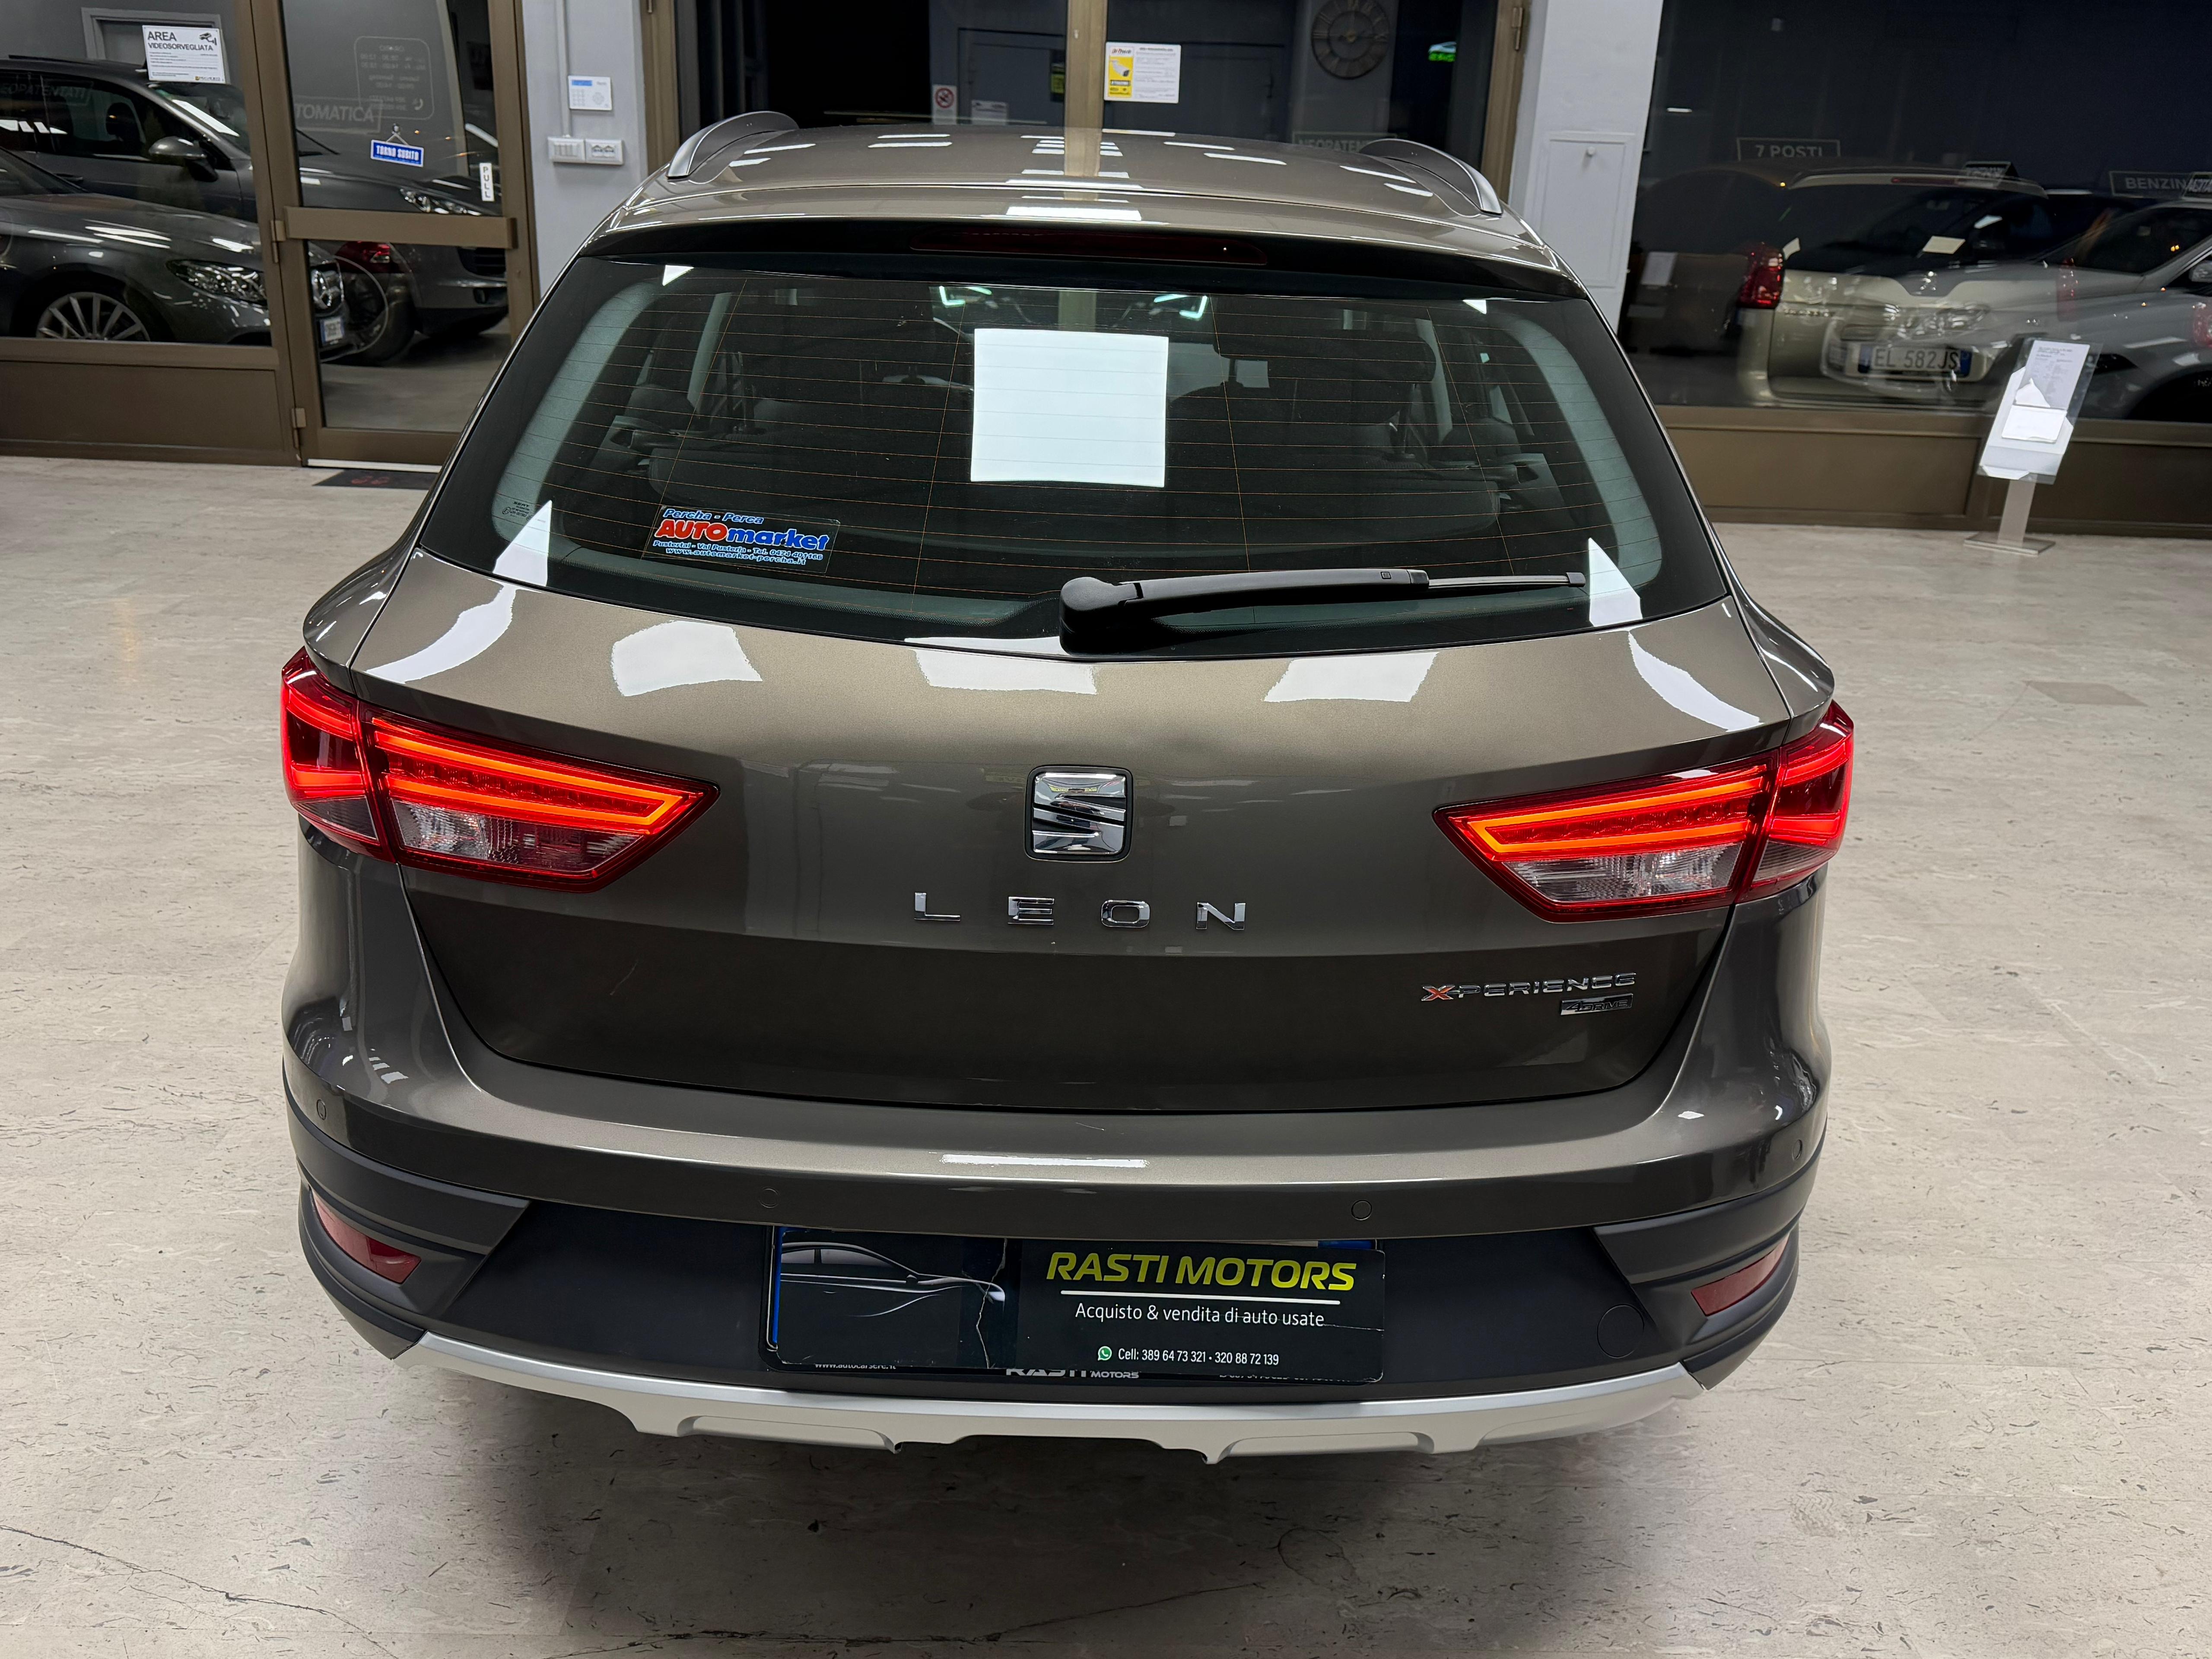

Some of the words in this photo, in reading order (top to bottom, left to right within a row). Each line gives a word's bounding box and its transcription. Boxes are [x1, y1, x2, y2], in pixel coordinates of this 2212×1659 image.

[148, 31, 177, 41] AREA
[148, 43, 213, 51] VIDEOSORVEGLIATA
[376, 145, 396, 157] TORNO
[397, 149, 419, 161] SUBITO
[1755, 145, 1764, 157] 7
[1770, 145, 1823, 157] POSTI
[483, 166, 491, 198] PULL
[1875, 348, 1895, 367] EL
[663, 509, 712, 520] Percha
[722, 512, 764, 524] Perca
[654, 519, 830, 550] AUTOmarket
[653, 540, 691, 548] Pustertal
[712, 544, 746, 553] Pusteria
[914, 892, 1246, 931] LEON
[1566, 999, 1629, 1012] 4DRIVE
[1046, 1252, 1169, 1284] RASTI
[1175, 1256, 1357, 1291] MOTORS
[1075, 1303, 1142, 1322] Acquisto
[1147, 1305, 1158, 1320] &
[1163, 1306, 1220, 1322] vendita
[1225, 1307, 1238, 1323] di
[1243, 1311, 1278, 1325] auto
[1282, 1312, 1325, 1327] usate
[1118, 1348, 1139, 1361] Cell:
[1142, 1349, 1160, 1361] 389
[1163, 1350, 1174, 1361] 64
[1177, 1350, 1188, 1362] 73
[1191, 1351, 1206, 1363] 321
[1215, 1351, 1232, 1363] 320
[1235, 1352, 1247, 1364] 88
[1250, 1353, 1261, 1364] 72
[1264, 1353, 1279, 1365] 139
[1090, 1370, 1140, 1379] MOTORS
